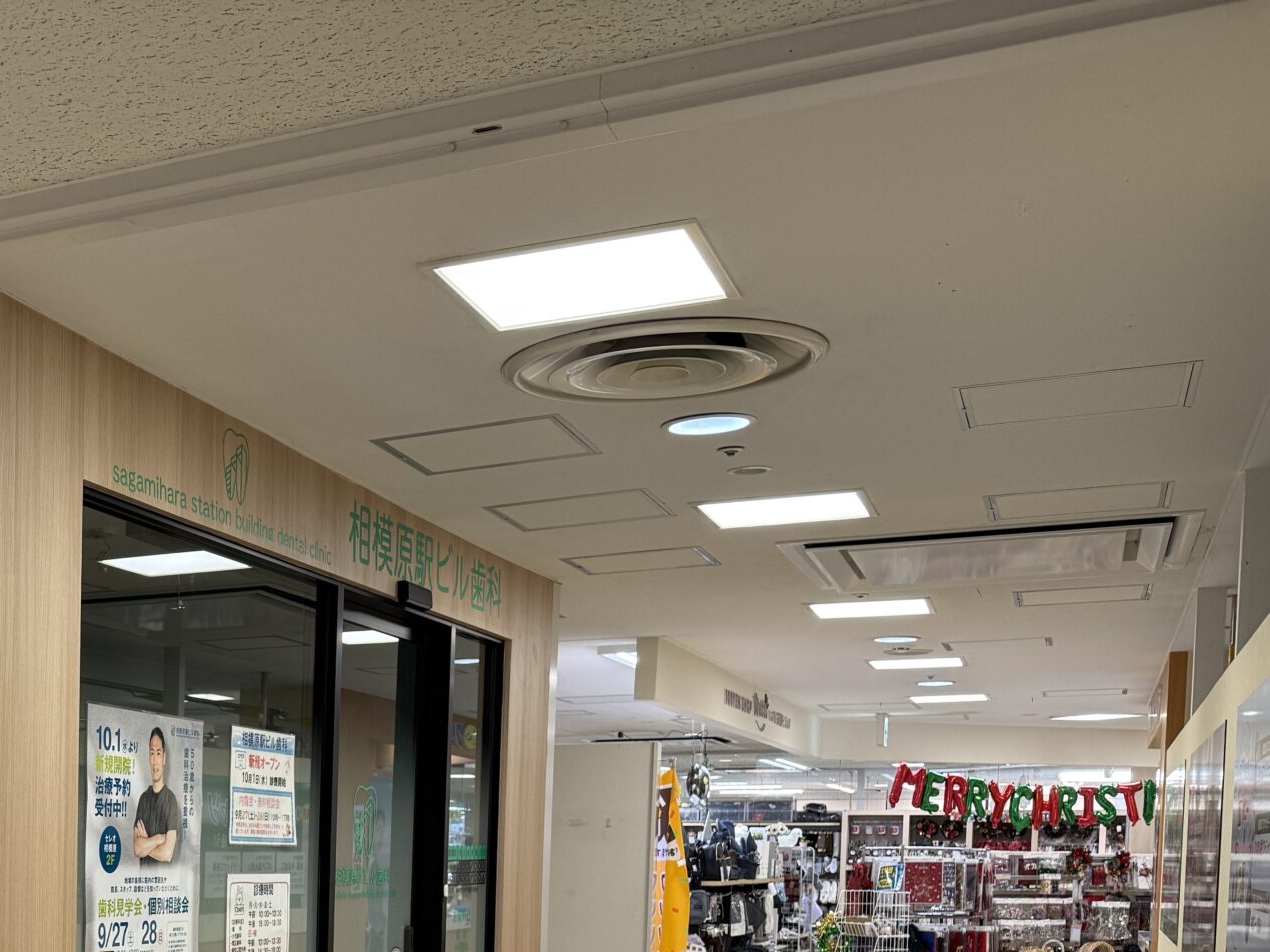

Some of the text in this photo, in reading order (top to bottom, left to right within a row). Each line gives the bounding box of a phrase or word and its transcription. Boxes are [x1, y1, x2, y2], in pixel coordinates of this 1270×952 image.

[112, 462, 332, 567] sagamihara station building dental clinic
[349, 500, 502, 620] 相模原駅ビル歯科
[95, 776, 130, 796] 治療予約
[106, 855, 115, 865] 2F
